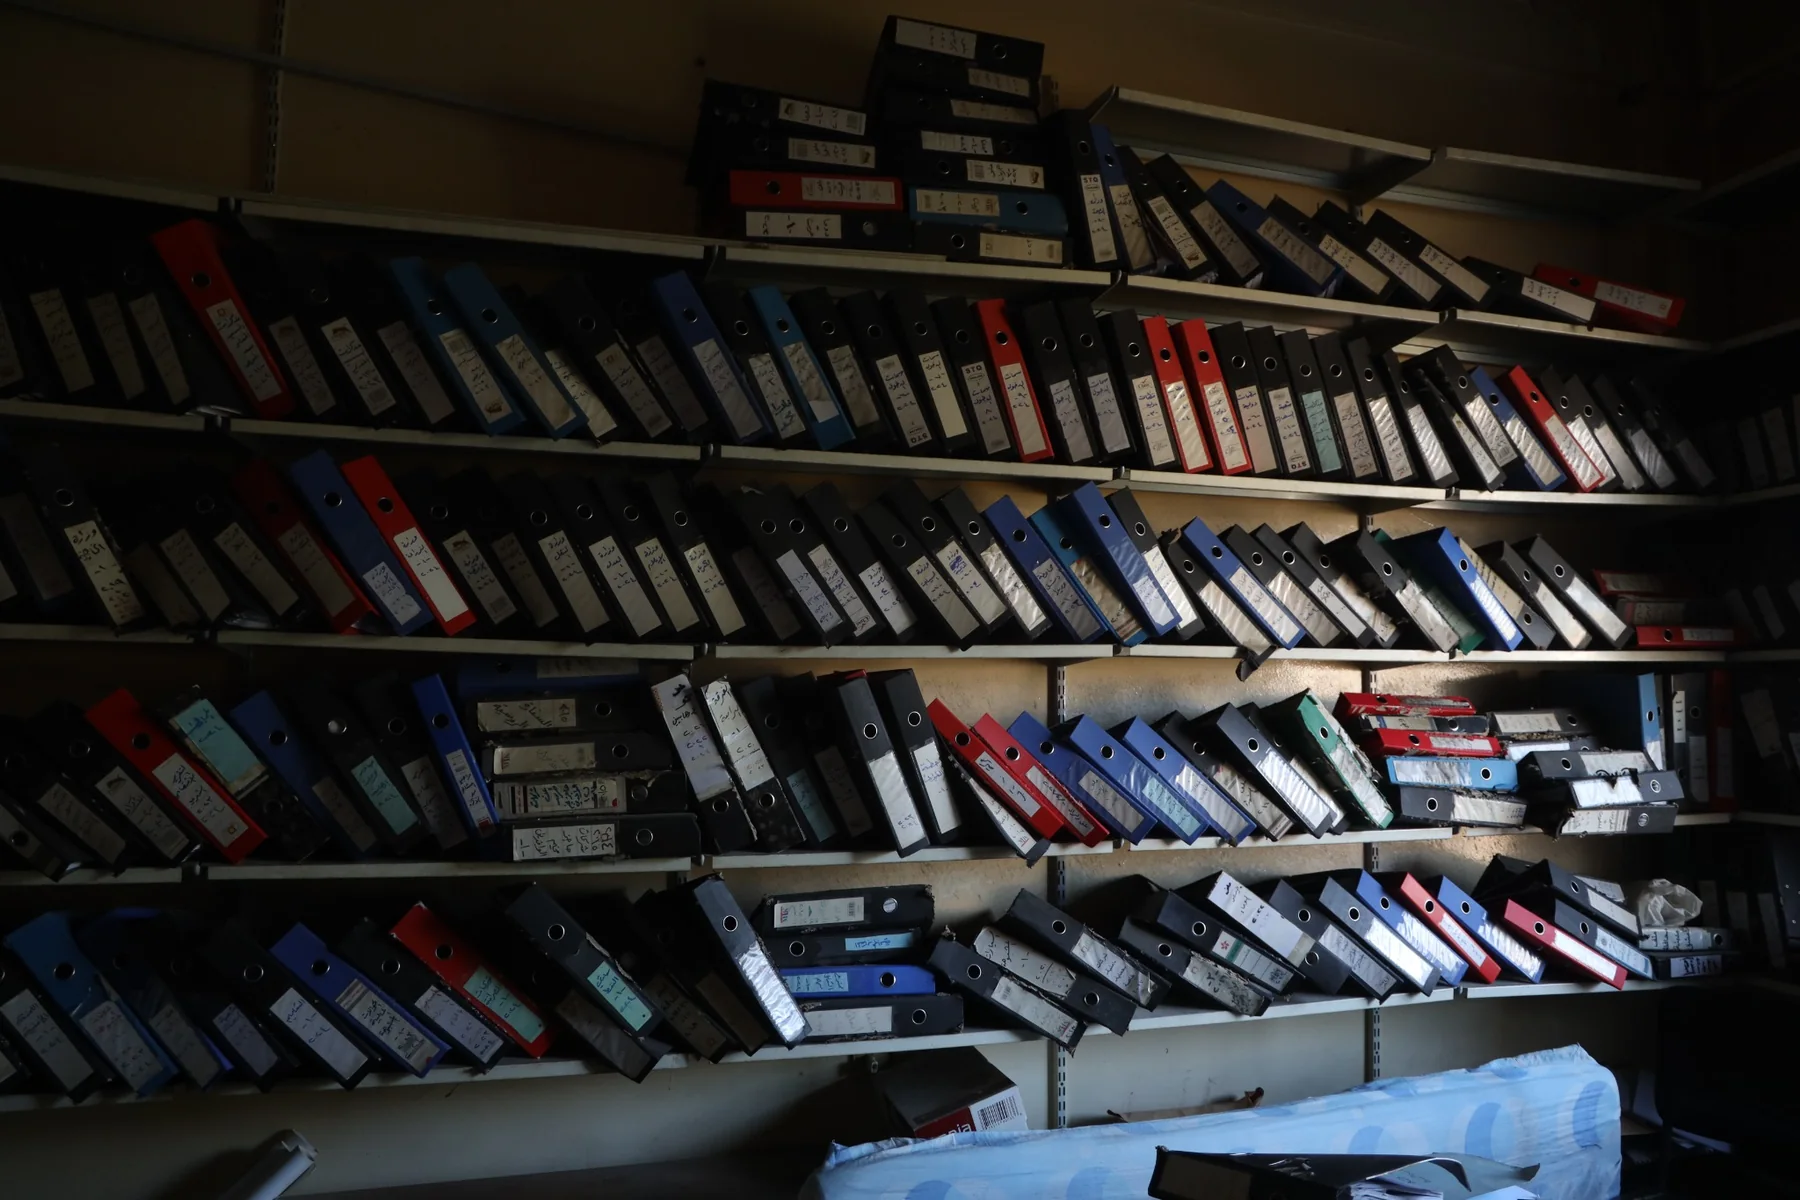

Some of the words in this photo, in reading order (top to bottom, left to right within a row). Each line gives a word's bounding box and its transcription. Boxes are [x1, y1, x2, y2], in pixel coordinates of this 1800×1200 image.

[519, 702, 553, 728] السفارة
[561, 829, 575, 853] حاجز
[576, 827, 590, 854] شركات
